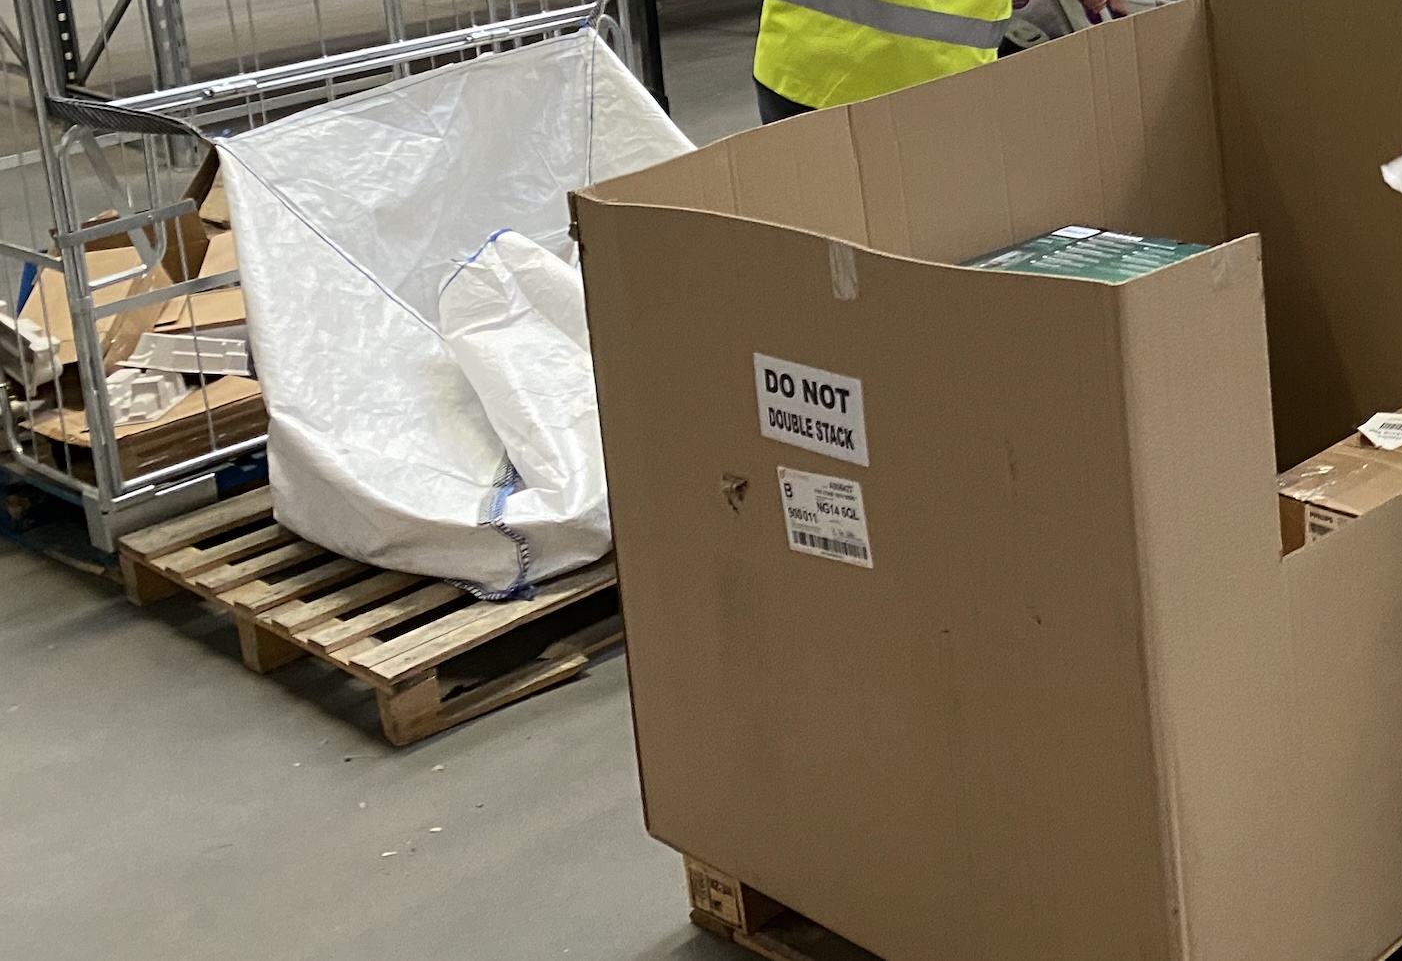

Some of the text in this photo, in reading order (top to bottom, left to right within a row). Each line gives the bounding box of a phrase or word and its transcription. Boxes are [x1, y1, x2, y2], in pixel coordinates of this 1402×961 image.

[764, 368, 850, 414] DO NOT
[768, 407, 854, 450] DOUBLE STACK
[784, 482, 793, 498] B
